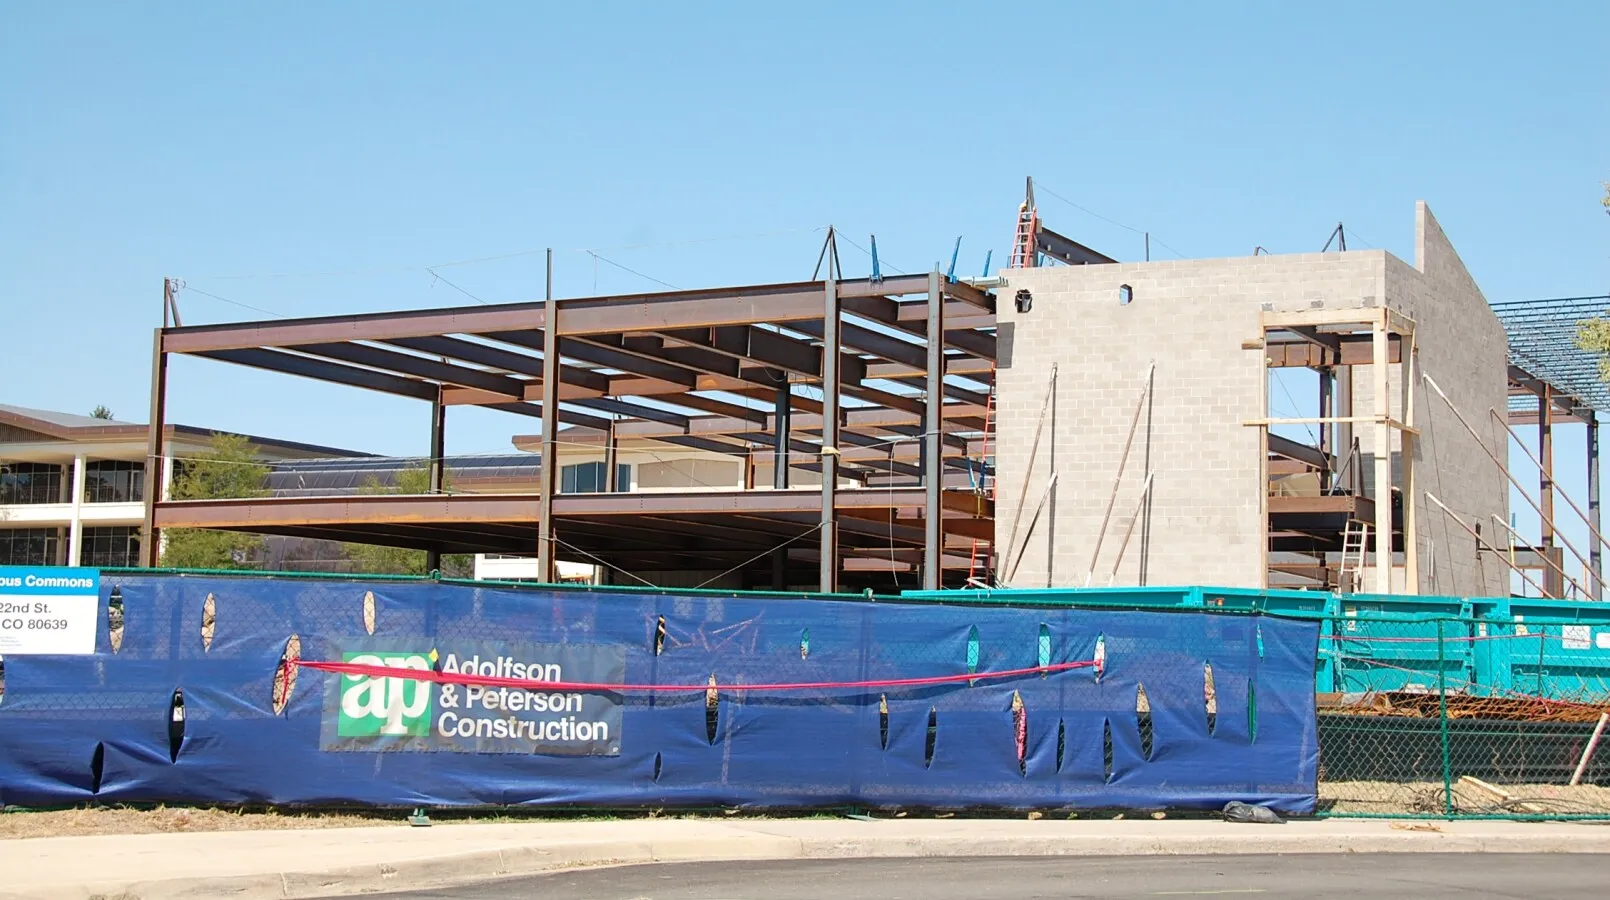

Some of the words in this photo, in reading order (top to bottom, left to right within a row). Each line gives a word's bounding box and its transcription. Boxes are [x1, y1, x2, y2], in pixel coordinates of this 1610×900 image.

[25, 575, 94, 588] Commons
[34, 602, 52, 614] St.
[2, 619, 24, 630] CO
[27, 619, 68, 630] 80639
[442, 653, 562, 682] Adolfson
[342, 654, 430, 735] ap
[439, 683, 459, 708] &
[466, 684, 583, 712] Peterson
[438, 711, 608, 741] Construction
